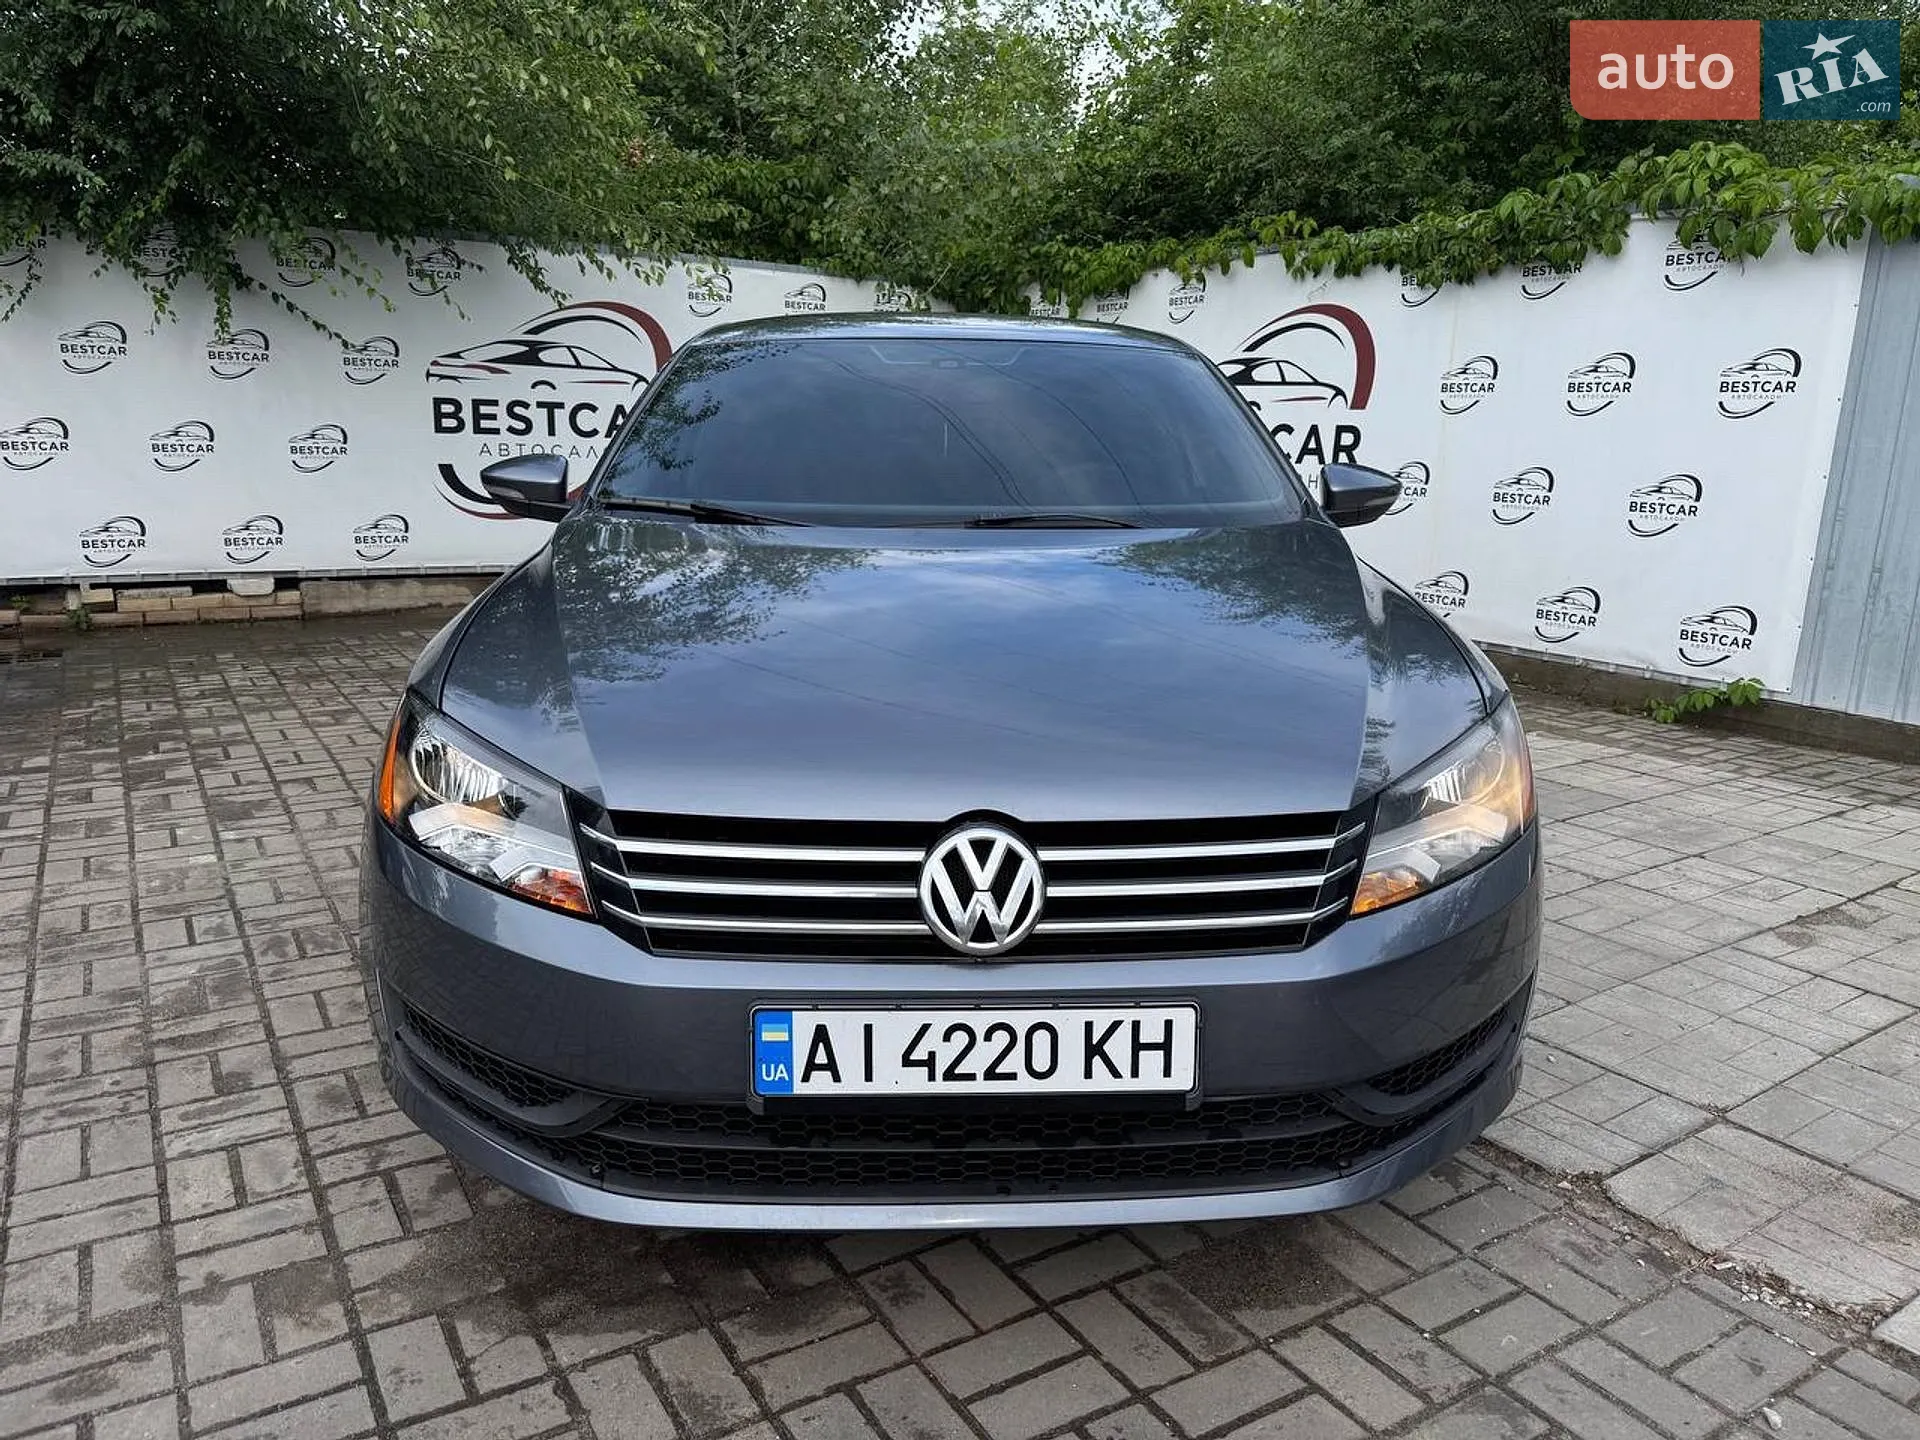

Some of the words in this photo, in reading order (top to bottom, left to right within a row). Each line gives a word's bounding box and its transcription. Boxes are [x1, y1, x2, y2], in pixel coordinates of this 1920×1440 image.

[784, 300, 826, 312] BESTCAR
[1168, 295, 1206, 307] BESTCAR
[60, 343, 128, 356] BESTCAR
[208, 350, 270, 363] BESTCAR
[343, 357, 399, 369] BESTCAR
[1441, 382, 1496, 393] BESTCAR
[1568, 382, 1632, 393] BESTCAR
[1719, 381, 1797, 393] BESTCAR
[432, 397, 628, 439] BESTCA
[1, 441, 69, 452] BESTCAR
[151, 443, 214, 454] BESTCAR
[290, 445, 348, 456] BESTCAR
[1493, 492, 1551, 506] BESTCAR
[1629, 501, 1698, 518] BESTCAR
[81, 539, 146, 550] BESTCAR
[224, 537, 283, 548] BESTCAR
[354, 535, 409, 545] BESTCAR
[1536, 609, 1597, 628] BESTCAR
[1680, 629, 1752, 650] BESTCAR
[901, 1020, 1059, 1082] 4220
[1082, 1018, 1174, 1080] KH
[762, 1063, 789, 1081] UA
